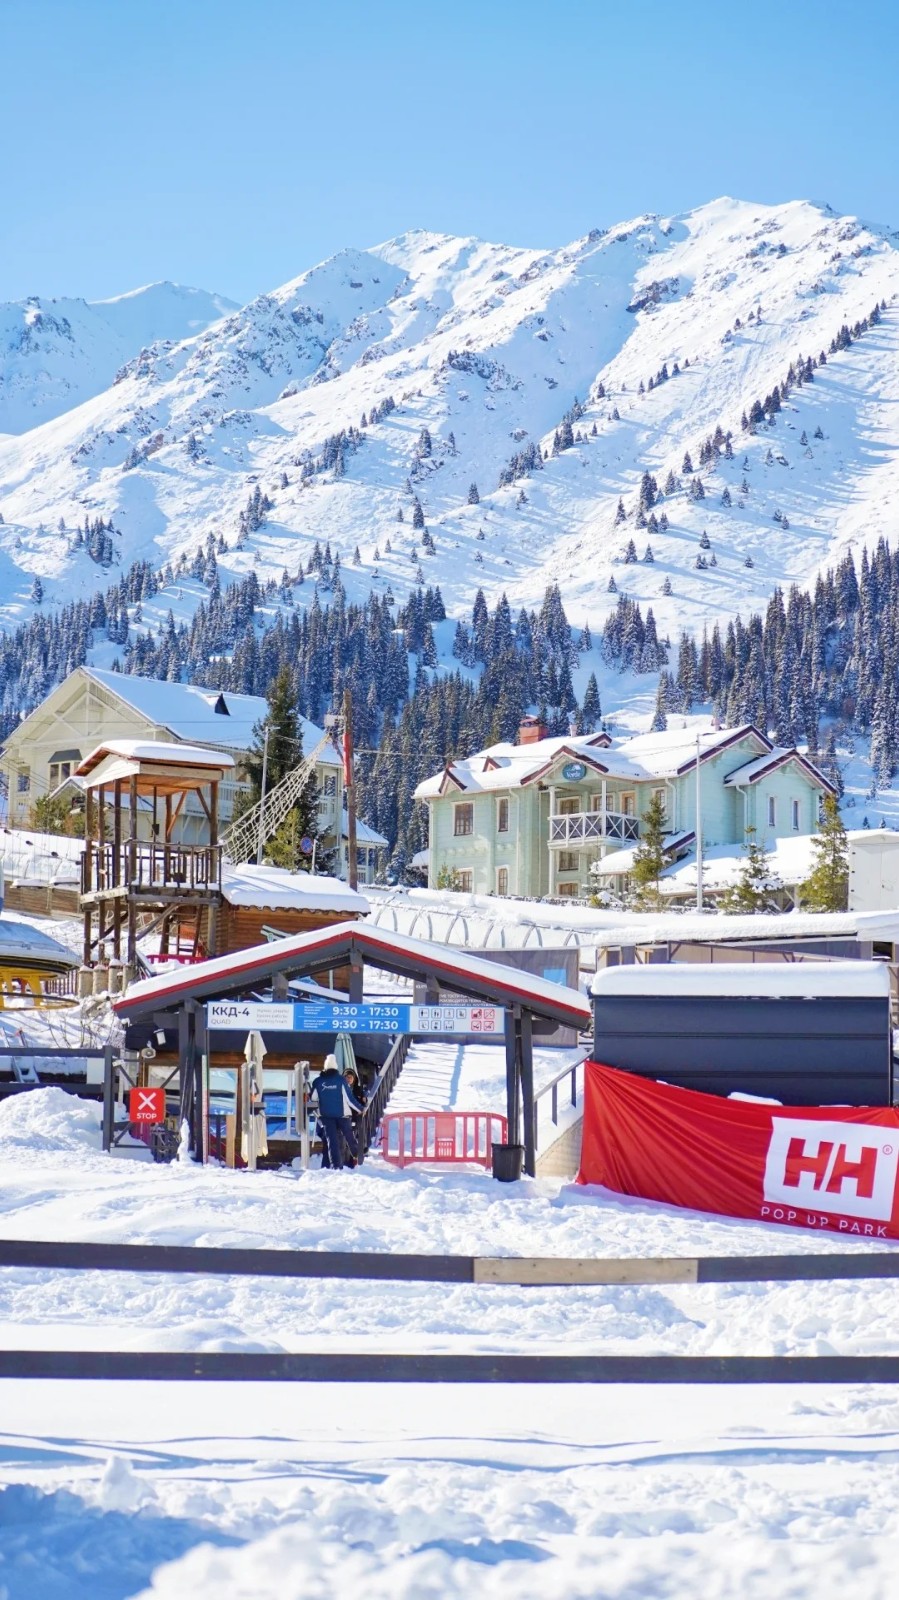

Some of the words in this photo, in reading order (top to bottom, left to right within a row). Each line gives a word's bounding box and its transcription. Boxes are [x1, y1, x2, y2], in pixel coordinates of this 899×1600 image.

[212, 1006, 250, 1017] ККД-4
[332, 1006, 358, 1015] 9:30
[369, 1007, 399, 1017] 17:30
[332, 1020, 357, 1029] 9:30
[369, 1020, 399, 1030] 17:30
[136, 1112, 157, 1120] STOP
[761, 1206, 797, 1221] POP
[807, 1215, 829, 1226] UP
[839, 1220, 888, 1238] PARK
